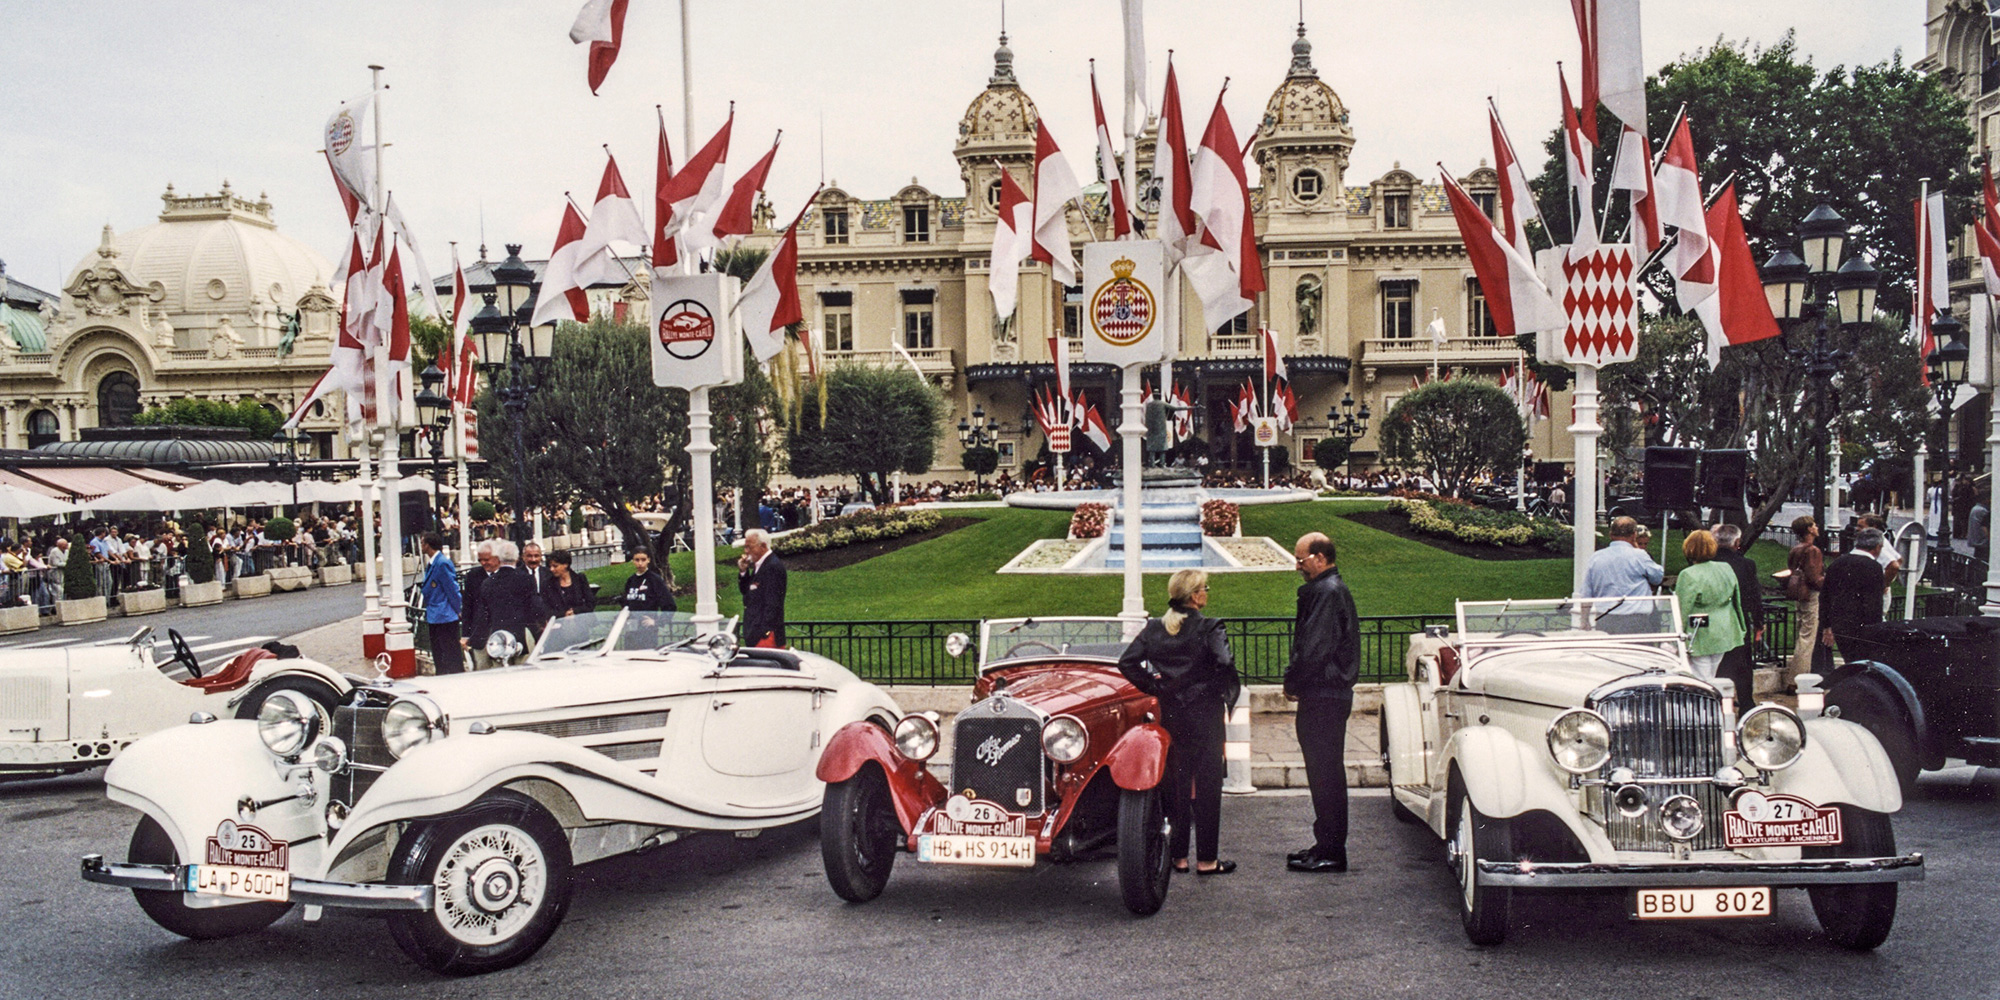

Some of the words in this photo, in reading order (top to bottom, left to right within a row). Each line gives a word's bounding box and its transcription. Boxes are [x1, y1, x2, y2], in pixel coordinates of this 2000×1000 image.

[974, 808, 990, 820] 26
[1773, 803, 1793, 819] 27
[937, 814, 964, 835] RALLYE
[965, 817, 1023, 837] MONTE-CARLO
[1729, 815, 1764, 838] RALLYE
[1765, 811, 1837, 837] MONTE-CARLO
[241, 835, 256, 849] 25
[933, 840, 953, 857] HB
[966, 842, 985, 858] HS
[990, 842, 1031, 859] 914H
[1747, 835, 1786, 844] VOITURES
[1790, 834, 1835, 842] ANCIENNES
[209, 840, 233, 865] RALLYE
[233, 846, 286, 868] MONTE-CARLO
[198, 869, 217, 889] LA
[230, 872, 240, 891] P
[244, 873, 285, 896] 600H
[1643, 894, 1695, 914] BBU
[1715, 891, 1765, 913] 802
